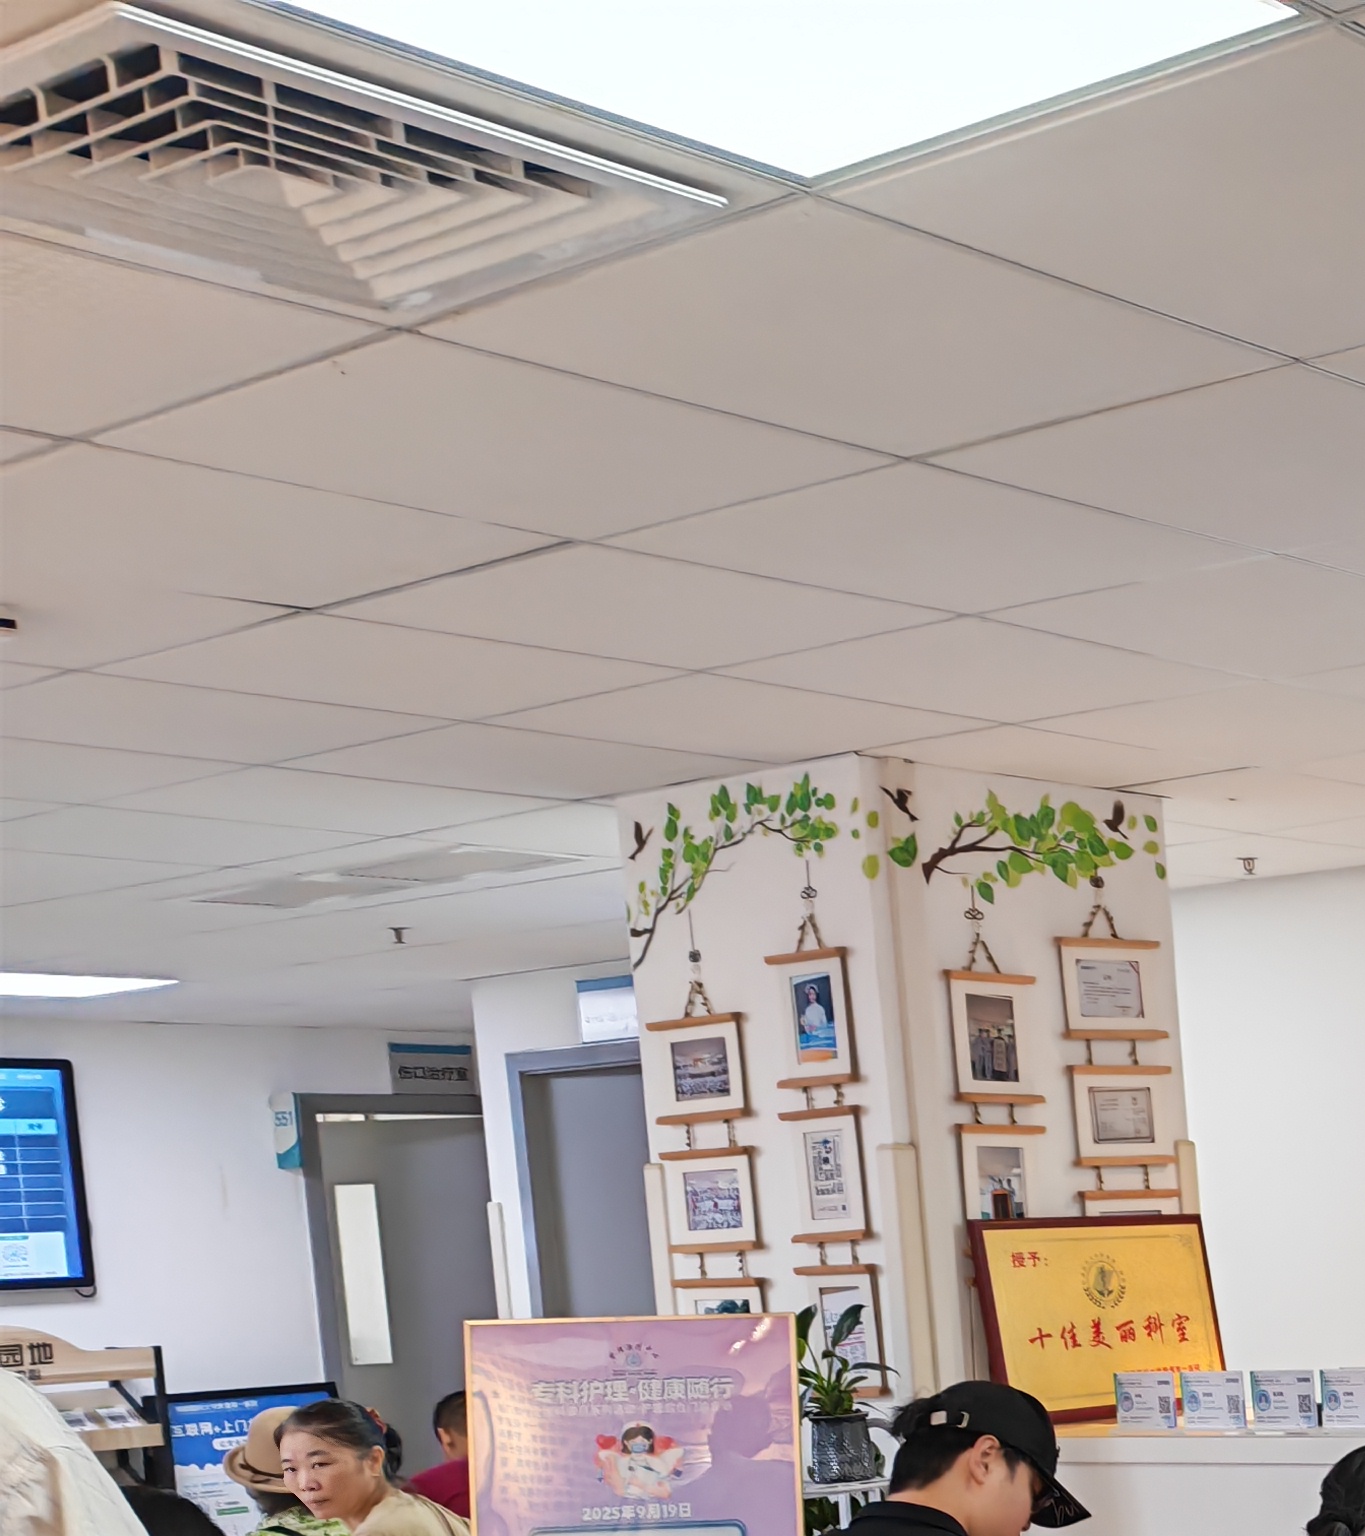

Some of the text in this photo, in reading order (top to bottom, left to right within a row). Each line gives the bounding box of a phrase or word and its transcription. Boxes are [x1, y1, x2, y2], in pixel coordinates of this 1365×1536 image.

[1029, 1312, 1192, 1351] 十佳美丽科室
[582, 1503, 692, 1521] 2025年9月19日
